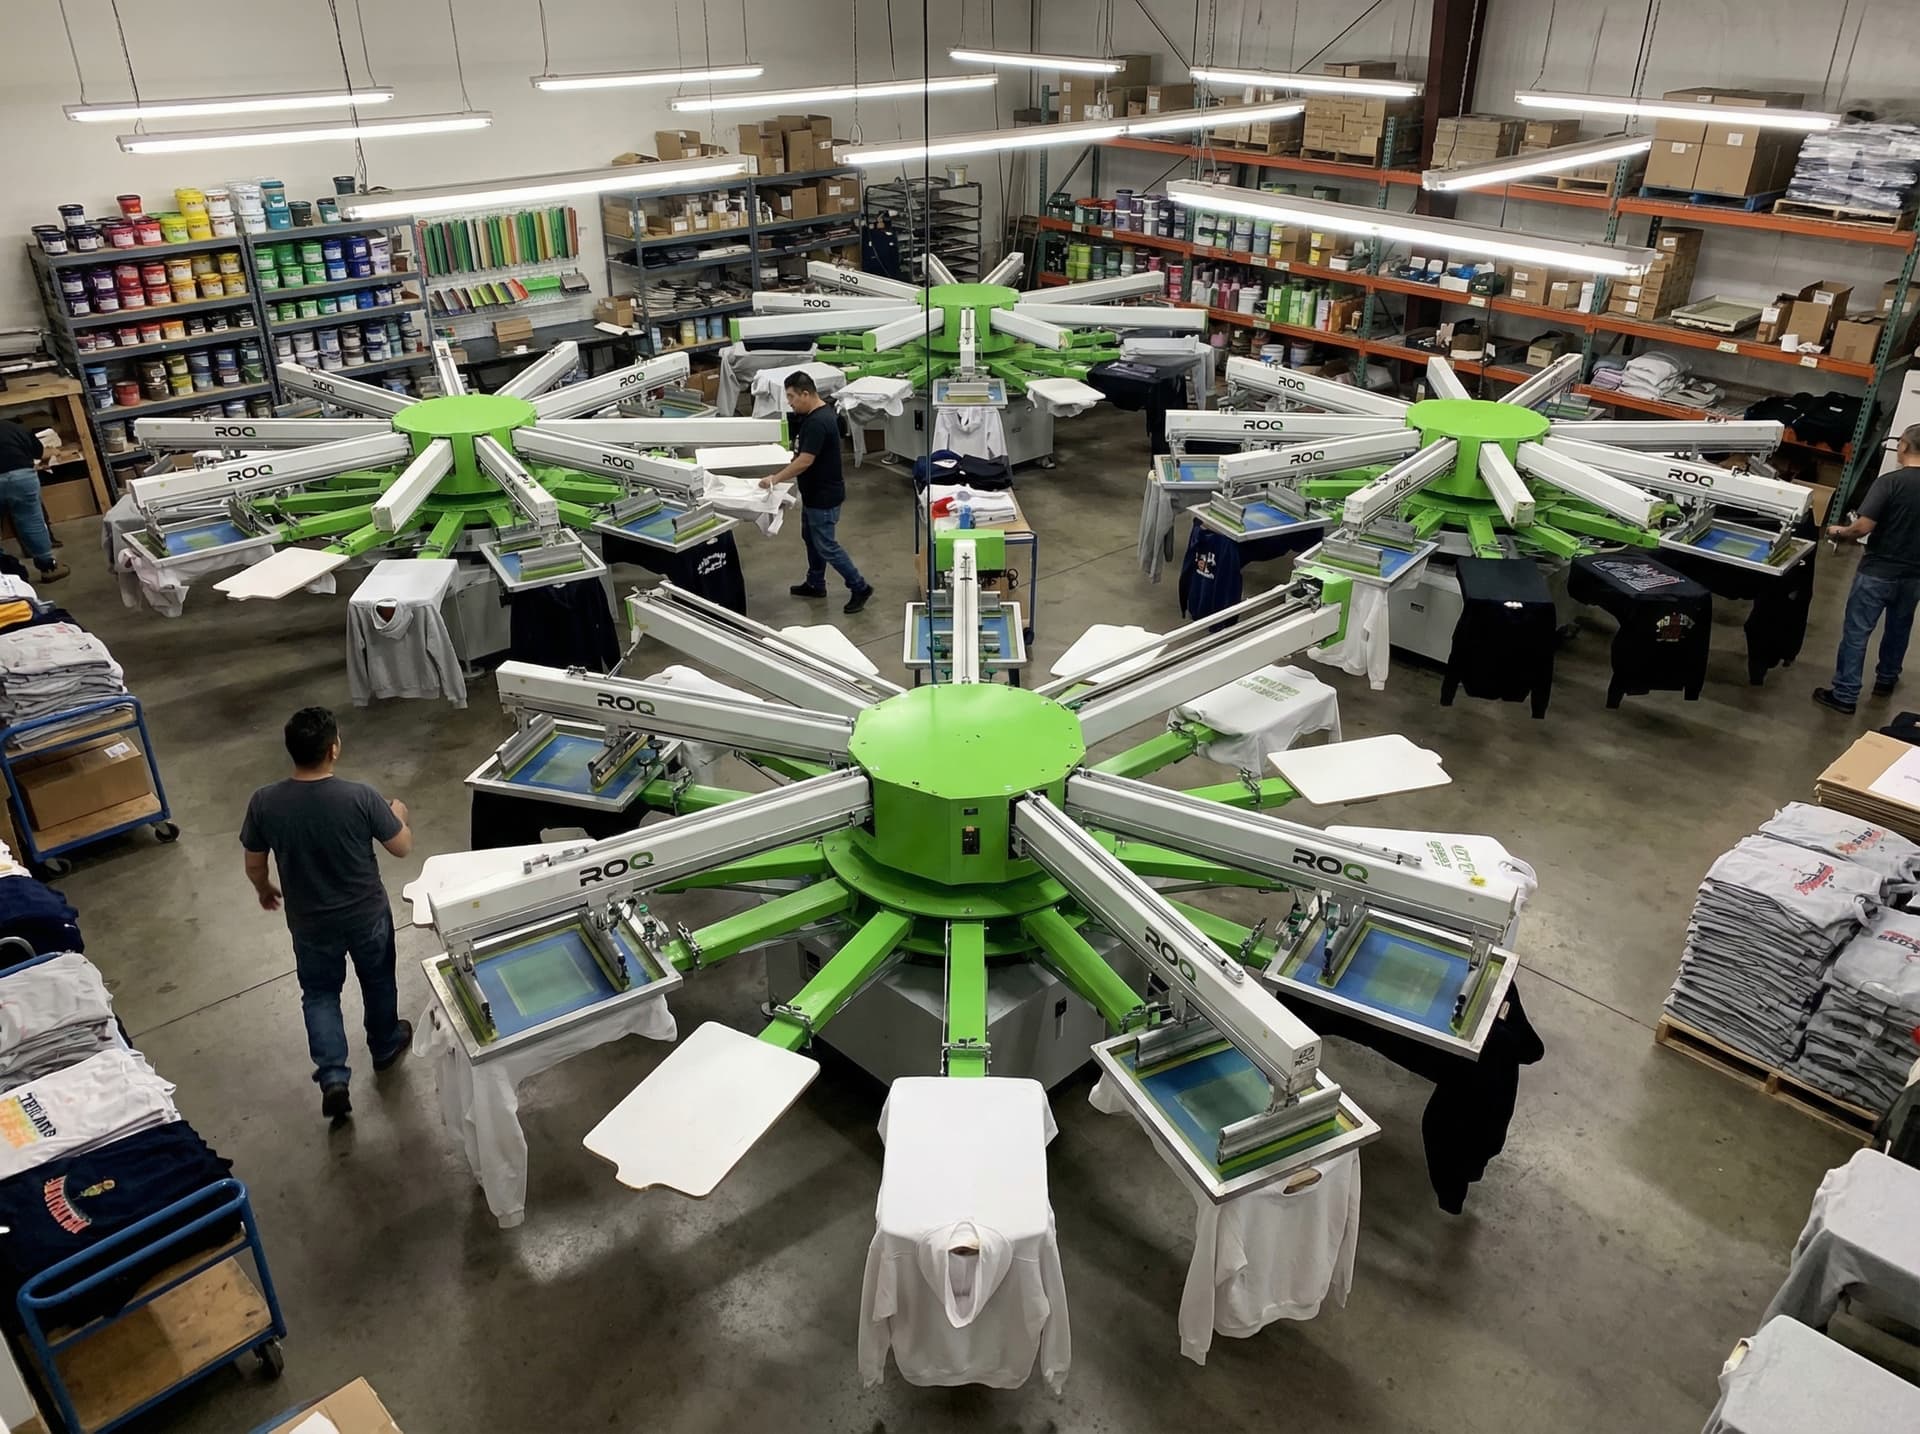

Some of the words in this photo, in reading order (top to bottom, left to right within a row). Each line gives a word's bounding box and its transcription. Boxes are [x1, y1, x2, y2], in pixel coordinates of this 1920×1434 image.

[620, 372, 645, 387] ROQ
[1278, 376, 1305, 391] ROQ
[214, 426, 257, 438] ROQ
[1243, 420, 1284, 431] ROQ
[602, 454, 634, 470] ROQ
[1290, 450, 1325, 465] ROQ
[227, 464, 273, 482] ROQ
[1668, 469, 1714, 487] ROQ
[597, 692, 656, 716] ROQ
[579, 851, 655, 887] ROQ
[1292, 848, 1369, 884] ROQ
[1144, 926, 1197, 987] ROQ
